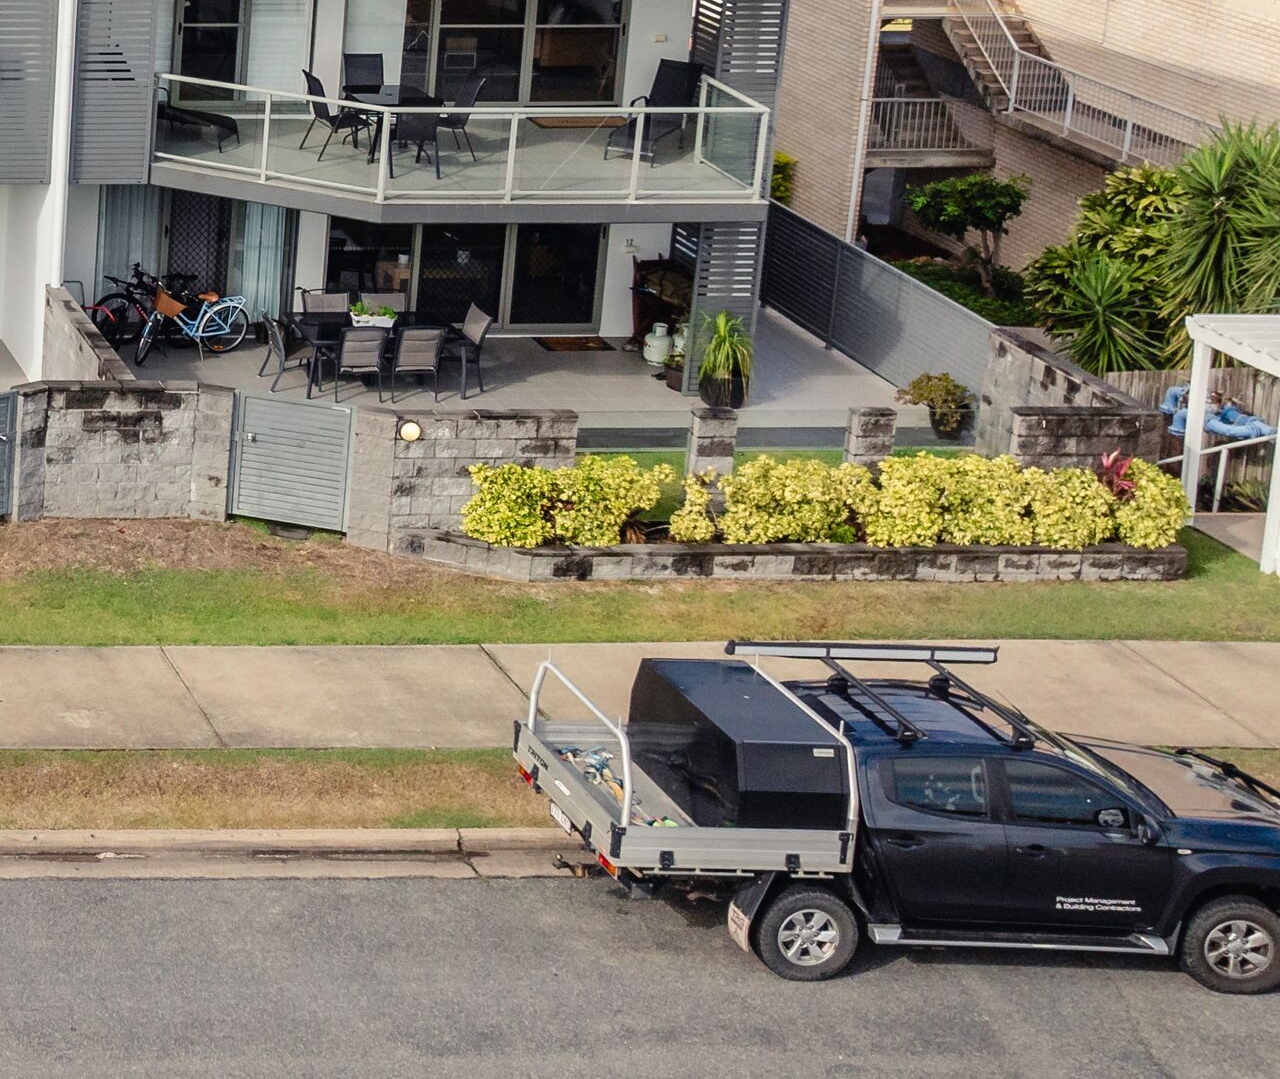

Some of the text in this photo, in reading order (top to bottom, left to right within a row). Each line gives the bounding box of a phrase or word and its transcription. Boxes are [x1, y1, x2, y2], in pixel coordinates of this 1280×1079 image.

[527, 745, 549, 771] TRITON
[1056, 896, 1136, 905] Project Management
[1095, 904, 1142, 912] Contractors
